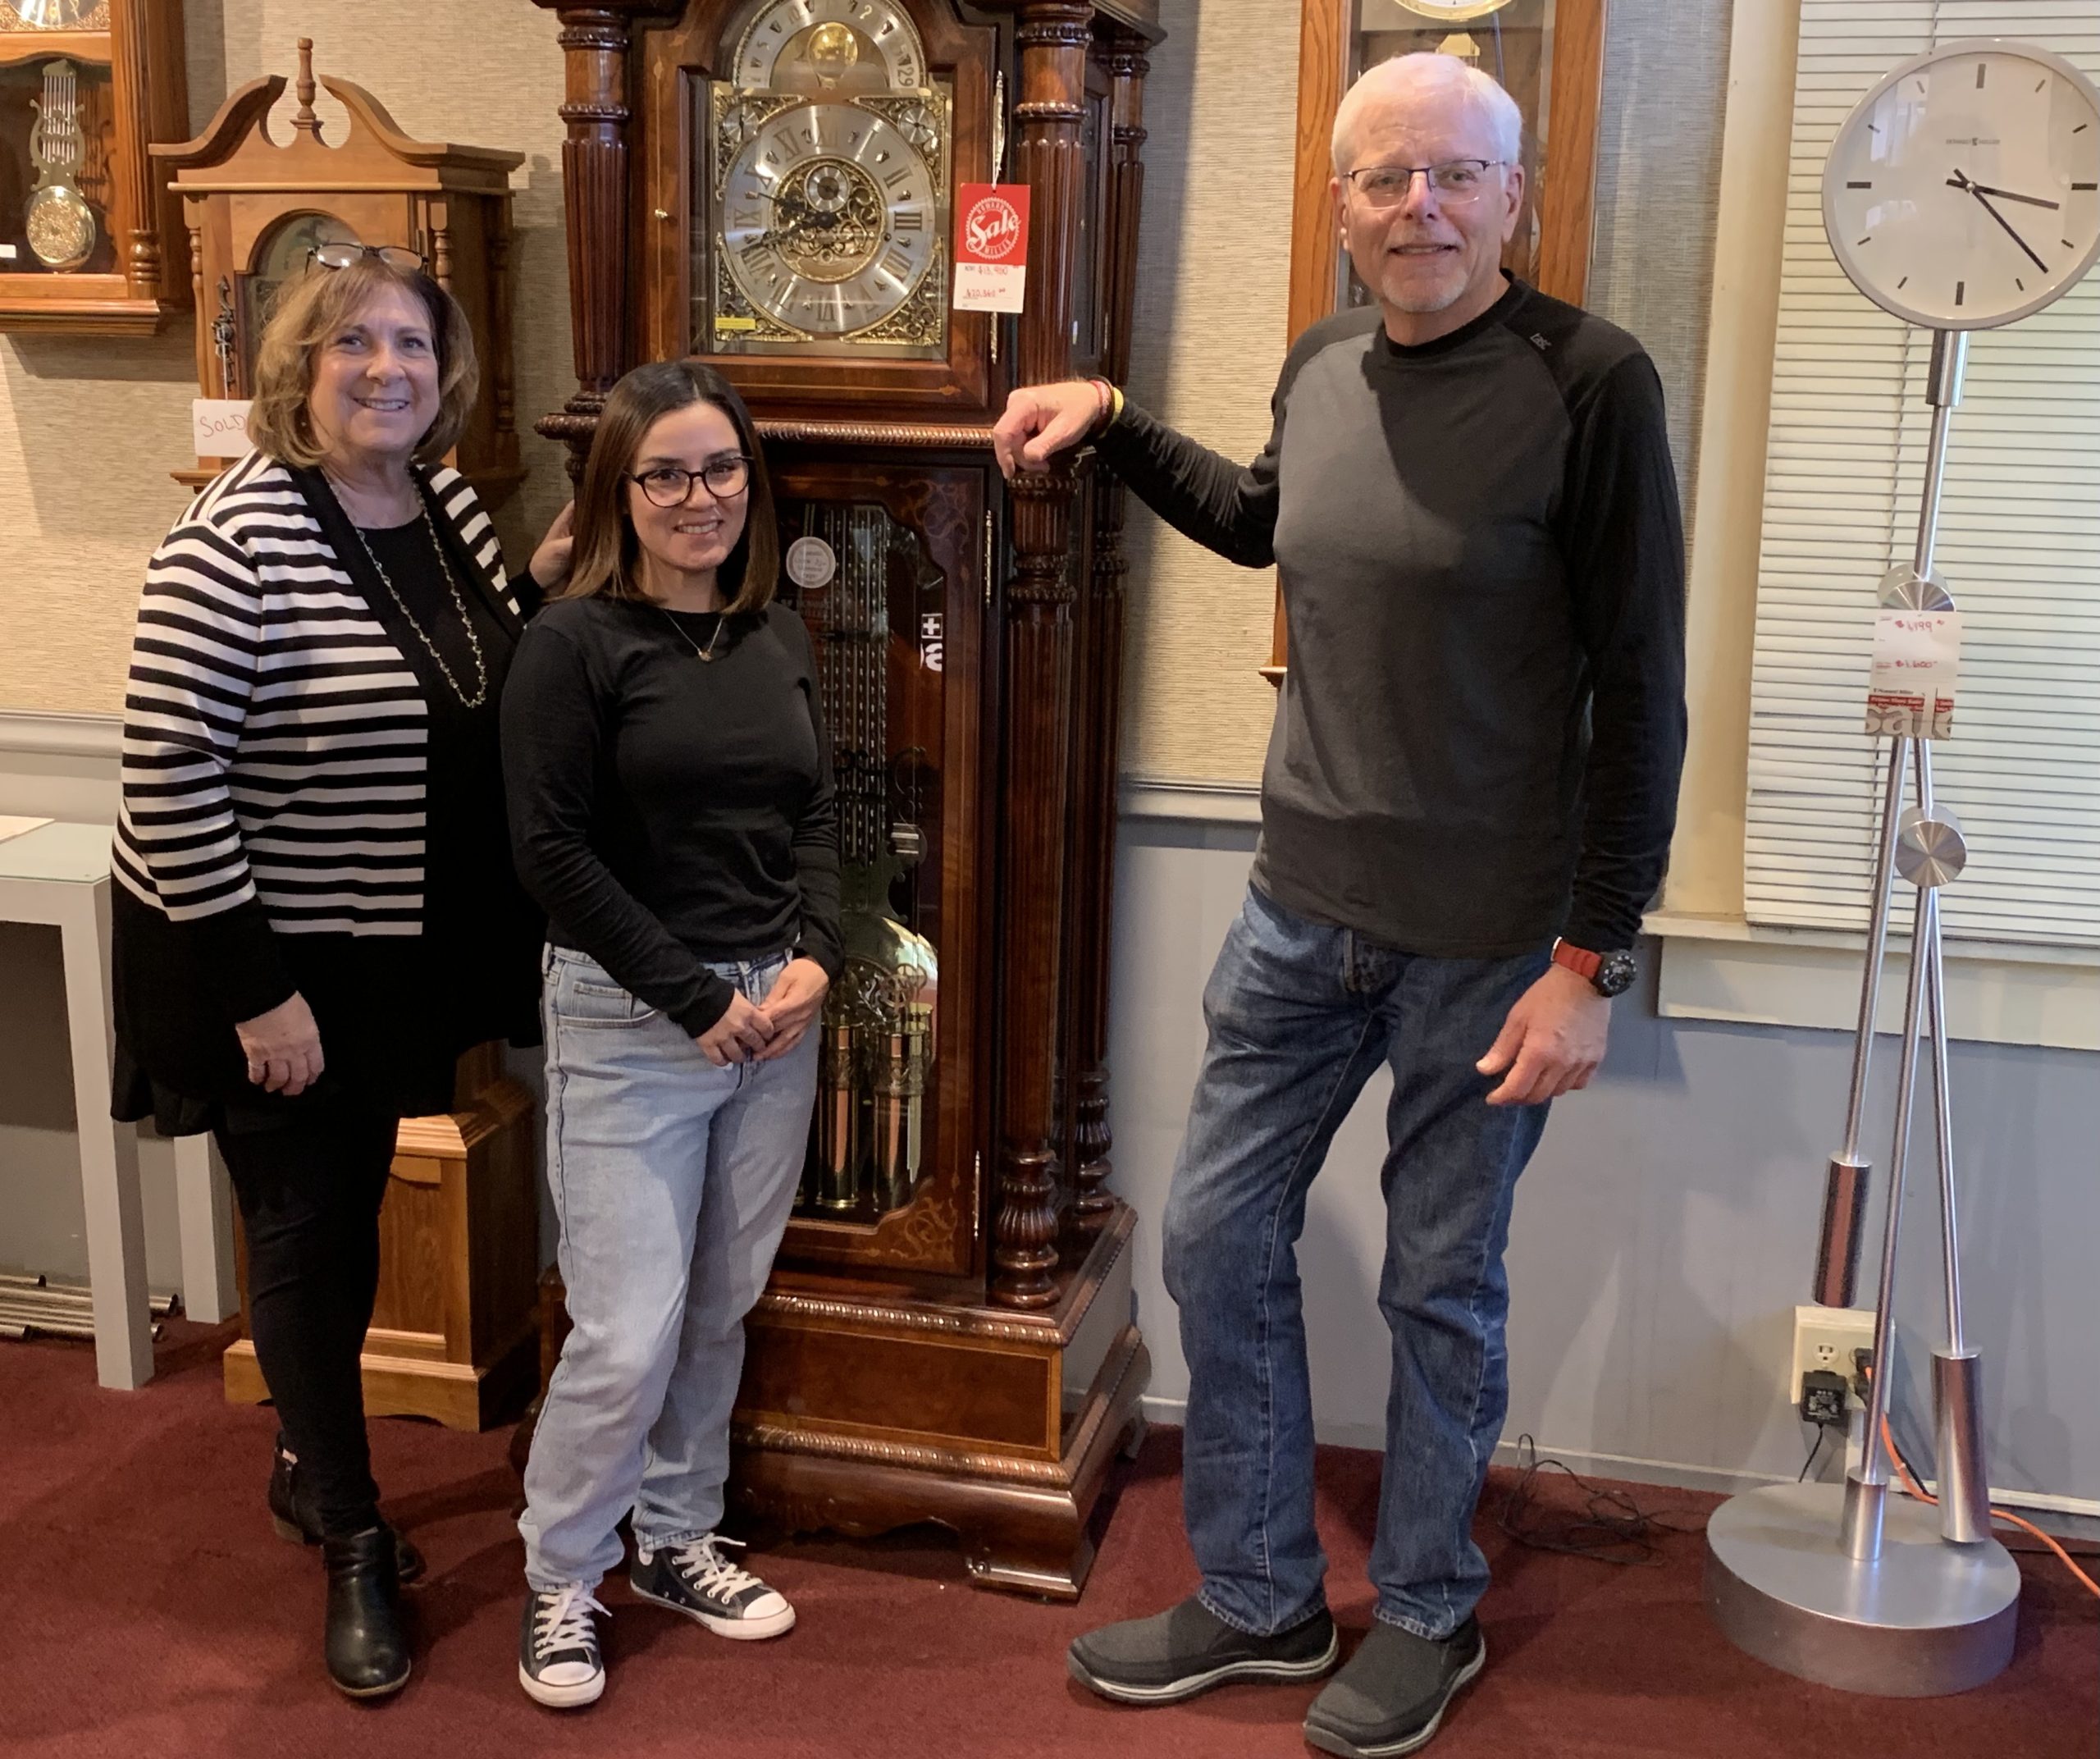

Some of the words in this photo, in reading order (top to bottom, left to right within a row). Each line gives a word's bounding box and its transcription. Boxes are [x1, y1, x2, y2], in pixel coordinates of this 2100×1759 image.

[894, 211, 922, 231] III
[966, 209, 1021, 252] Sale
[199, 414, 246, 437] SOLD
